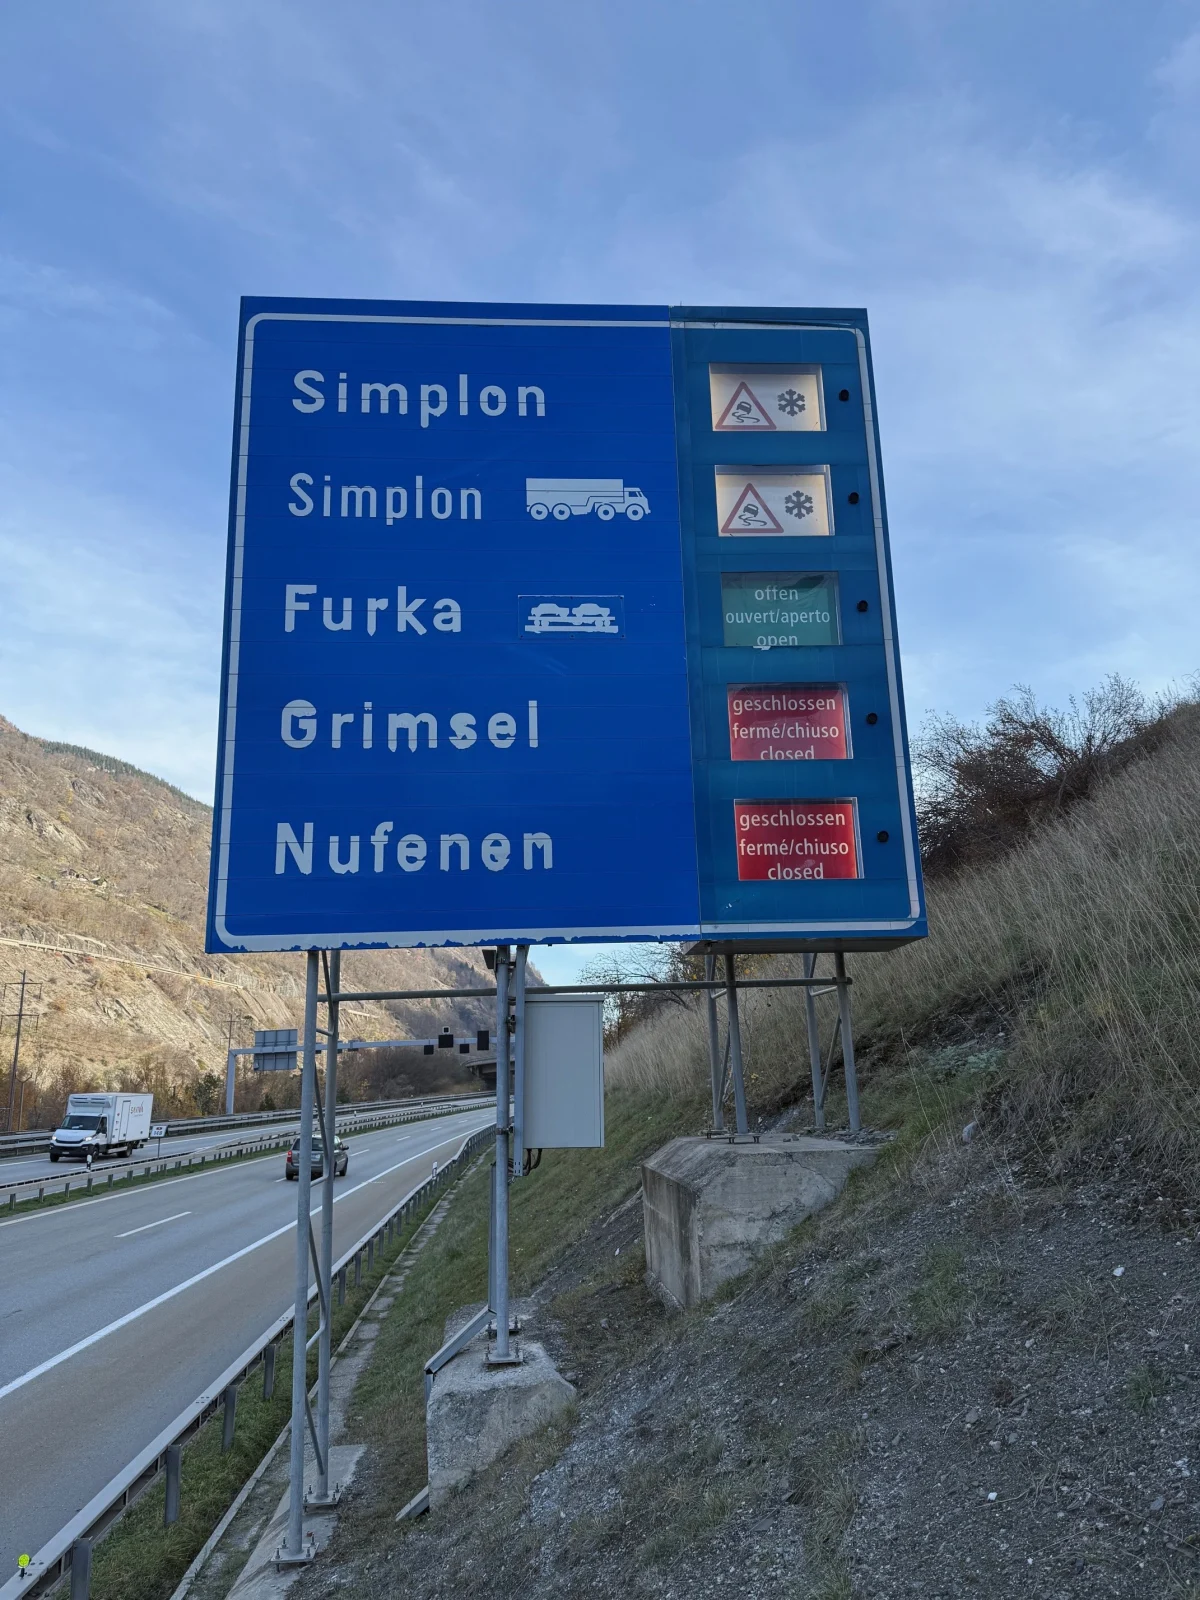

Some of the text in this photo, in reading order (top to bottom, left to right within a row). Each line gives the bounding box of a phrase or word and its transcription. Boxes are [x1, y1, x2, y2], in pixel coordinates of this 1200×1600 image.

[292, 369, 546, 429] Simplon
[287, 472, 482, 526] Simplon
[754, 585, 799, 601] offen
[284, 584, 462, 637] Furka
[725, 608, 830, 627] ouvert/aperto
[756, 635, 798, 646] open
[732, 694, 836, 716] geschlossen
[280, 699, 539, 753] Grimsel
[732, 722, 840, 739] fermé/chiuso
[760, 745, 815, 760] closed
[740, 809, 846, 831] geschlossen
[274, 821, 554, 875] Nufenen
[739, 838, 849, 856] fermé/chiuso
[767, 862, 824, 880] closed
